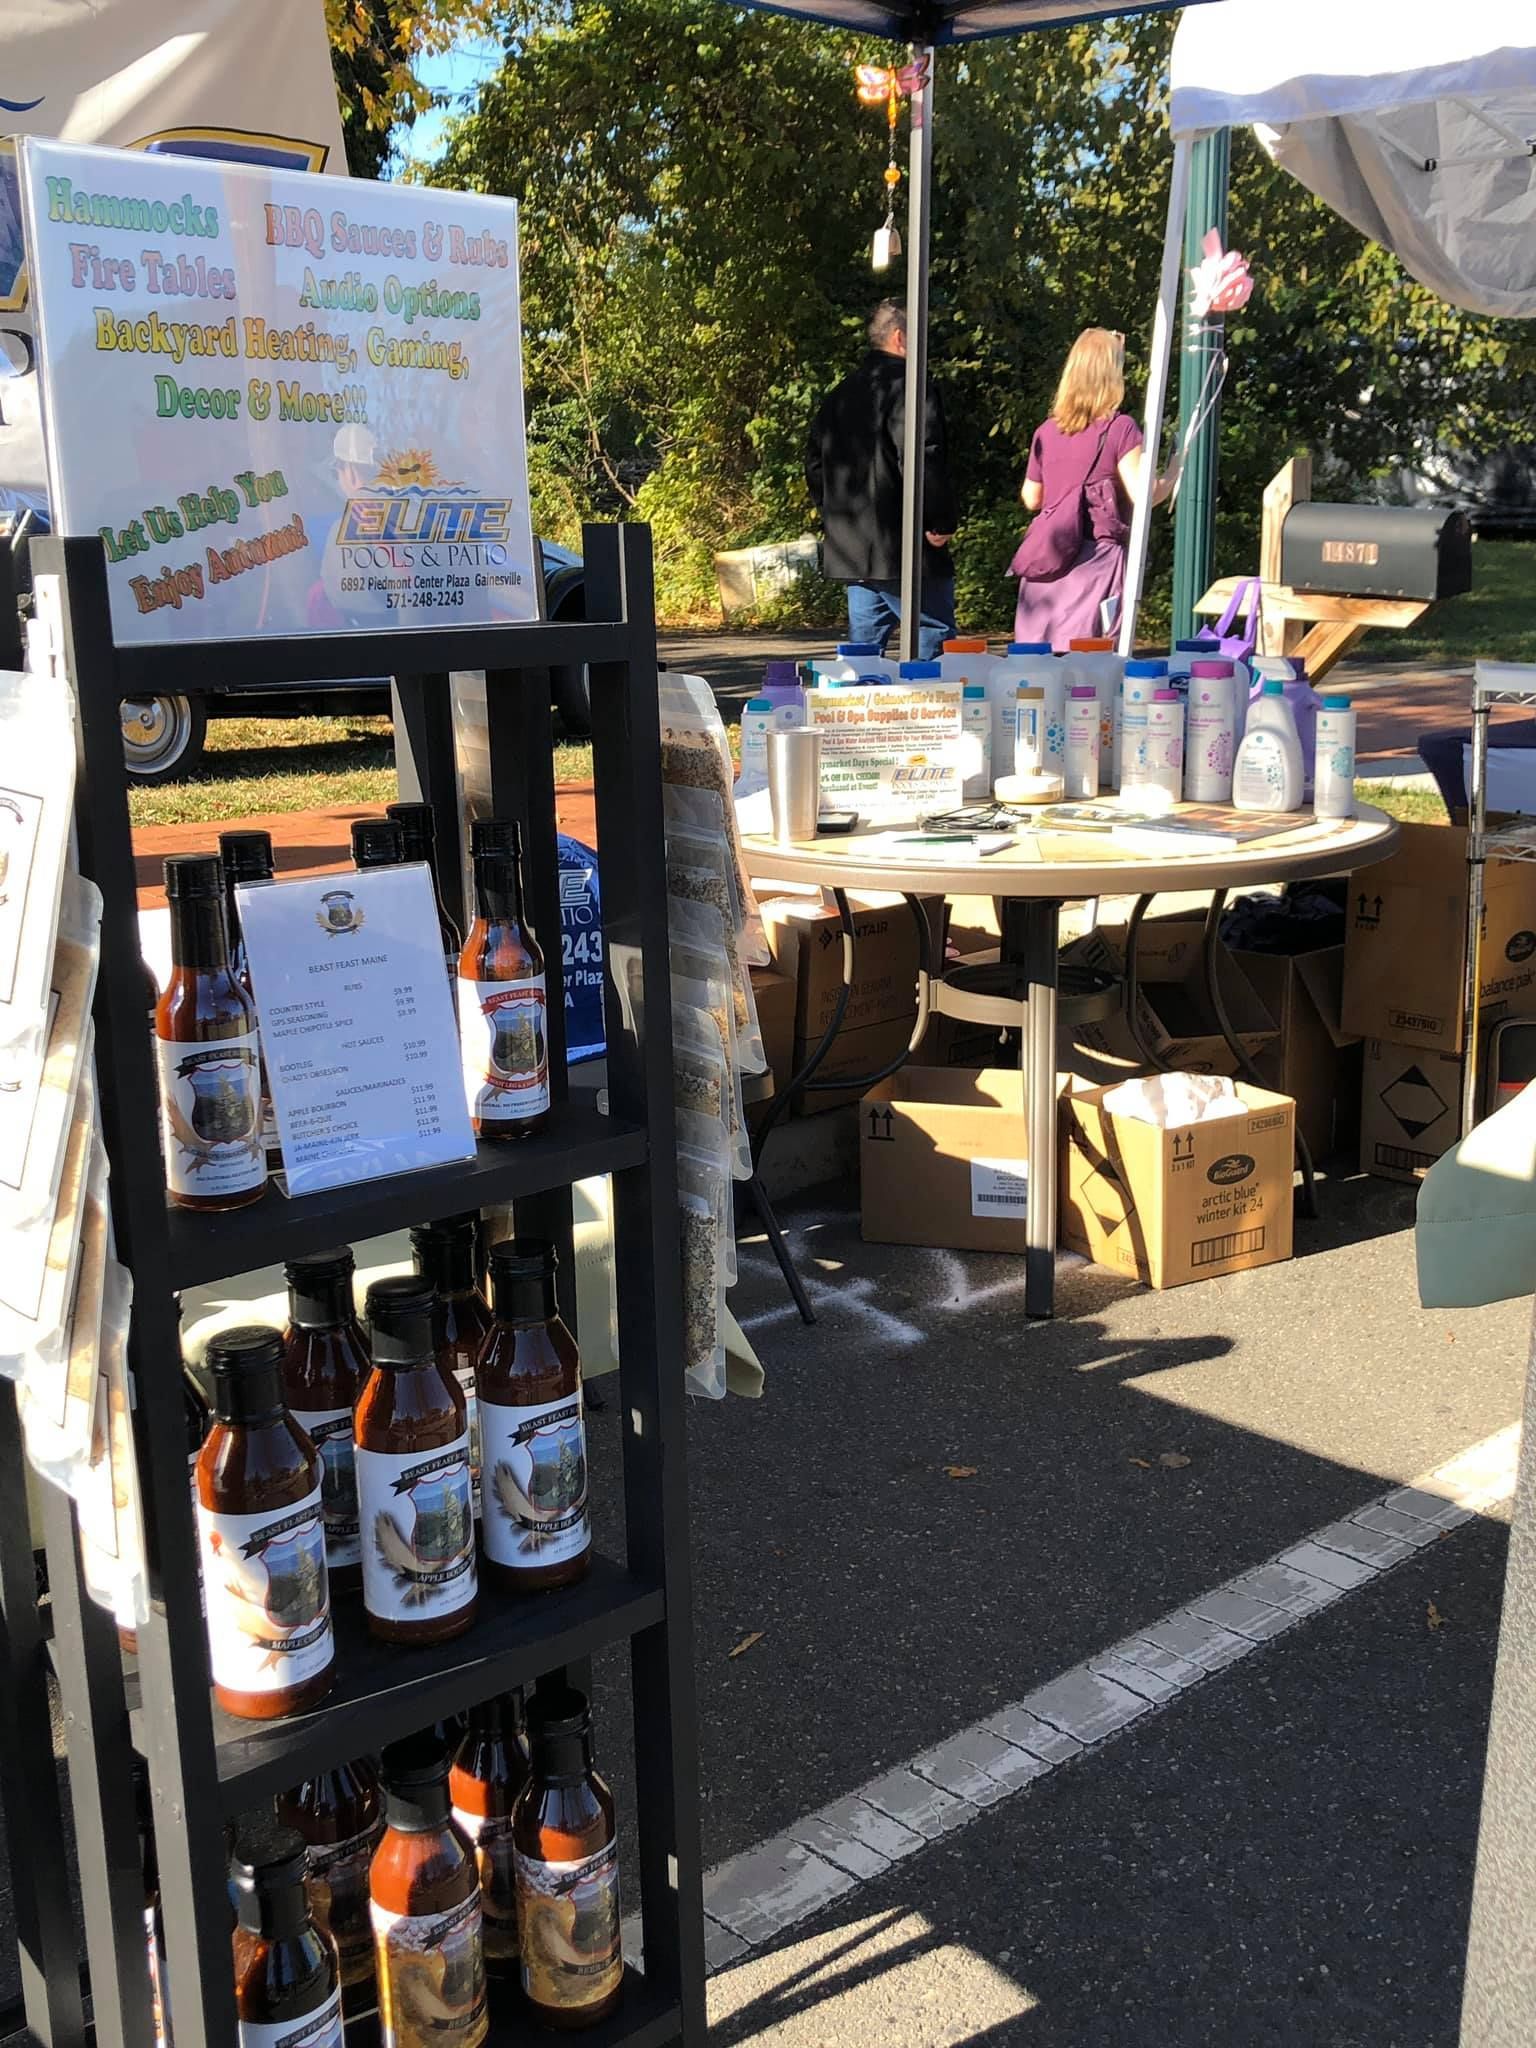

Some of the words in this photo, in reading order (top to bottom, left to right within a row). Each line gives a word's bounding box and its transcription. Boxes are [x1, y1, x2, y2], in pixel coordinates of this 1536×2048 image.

[45, 176, 220, 238] Hammocks
[264, 203, 325, 260] BBQ
[331, 211, 417, 259] Sauces
[422, 221, 444, 261] &
[448, 225, 509, 268] Rubs
[69, 242, 136, 292] Fire
[141, 249, 236, 300] Tables
[300, 266, 378, 313] Audio
[384, 275, 481, 324] Options
[93, 307, 239, 364] Backyard
[243, 317, 358, 374] Heating,
[367, 326, 470, 380] Gaming,
[154, 375, 241, 419] Decor
[248, 378, 272, 421] &
[277, 380, 368, 424] More!!!
[98, 520, 149, 563] Let
[143, 506, 184, 544] Us
[177, 485, 240, 532] Help
[234, 470, 289, 507] You
[336, 499, 512, 545] ELITE
[341, 546, 415, 569] POOLS
[421, 546, 440, 567] &
[449, 544, 507, 567] PATIO
[129, 562, 205, 614] Enjoy
[341, 577, 365, 591] 6892
[368, 575, 411, 590] Piedmont
[414, 574, 443, 589] Center
[447, 573, 470, 588] Plaza
[475, 571, 521, 586] Gainesville
[386, 590, 464, 609] 571-248-2243
[308, 961, 334, 974] BEAST
[335, 958, 360, 970] FEAST
[361, 954, 388, 966] MAINE
[269, 1002, 304, 1016] COUNTRY
[304, 1000, 325, 1010] STYLE
[286, 1011, 329, 1025] SEASONING
[272, 1027, 297, 1038] MAPLE
[300, 1022, 333, 1034] CHIPOTLE
[334, 1018, 353, 1028] SPICE
[342, 1039, 358, 1049] HOT
[358, 1035, 384, 1046] SAUCES
[279, 1060, 313, 1073] BOOTLEG
[310, 1066, 348, 1079] OBSESSION
[335, 1077, 406, 1097] SAUCES/MARINADES
[288, 1108, 309, 1118] APPLE
[311, 1101, 347, 1113] BOURBON
[411, 1083, 434, 1094] $11.99
[413, 1094, 436, 1105] $11.99
[332, 1121, 359, 1132] CHOICE
[415, 1105, 437, 1115] $11.99
[417, 1116, 439, 1127] $11.99
[296, 1152, 320, 1163] MAINE
[419, 1127, 441, 1138] $11.99
[1214, 1163, 1249, 1180] BioGuard
[1202, 1190, 1231, 1208] arctic
[1197, 1207, 1230, 1225] winter
[1234, 1202, 1247, 1217] kit
[1250, 1197, 1264, 1212] 24
[521, 1418, 547, 1433] BEAST
[548, 1409, 570, 1422] FEAST
[404, 1467, 432, 1480] BEAST
[432, 1458, 456, 1470] FEAST
[534, 1522, 560, 1531] APPLE
[418, 1572, 444, 1583] APPLE
